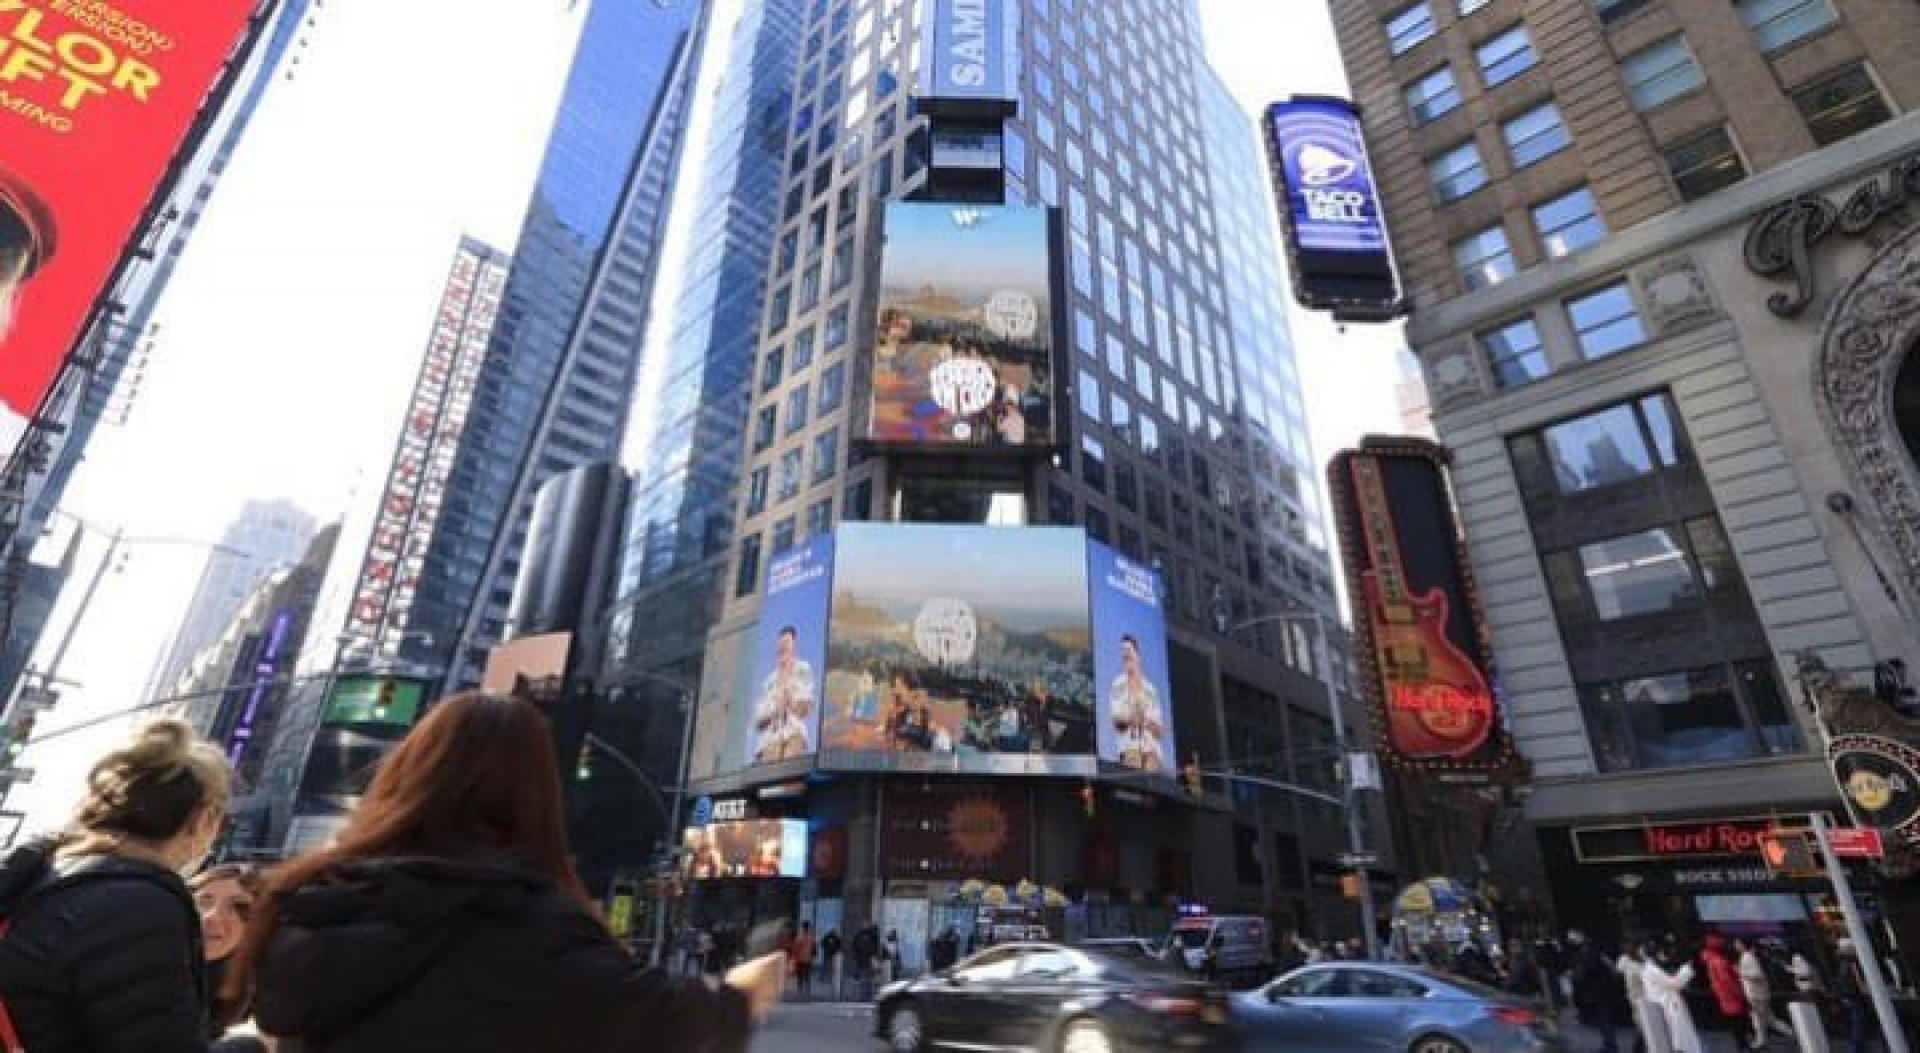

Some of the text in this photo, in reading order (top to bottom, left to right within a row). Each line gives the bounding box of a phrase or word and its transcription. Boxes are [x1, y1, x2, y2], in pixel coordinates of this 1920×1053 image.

[1299, 188, 1365, 206] TACO
[1306, 203, 1368, 222] BELL
[1646, 825, 1712, 853] Hard
